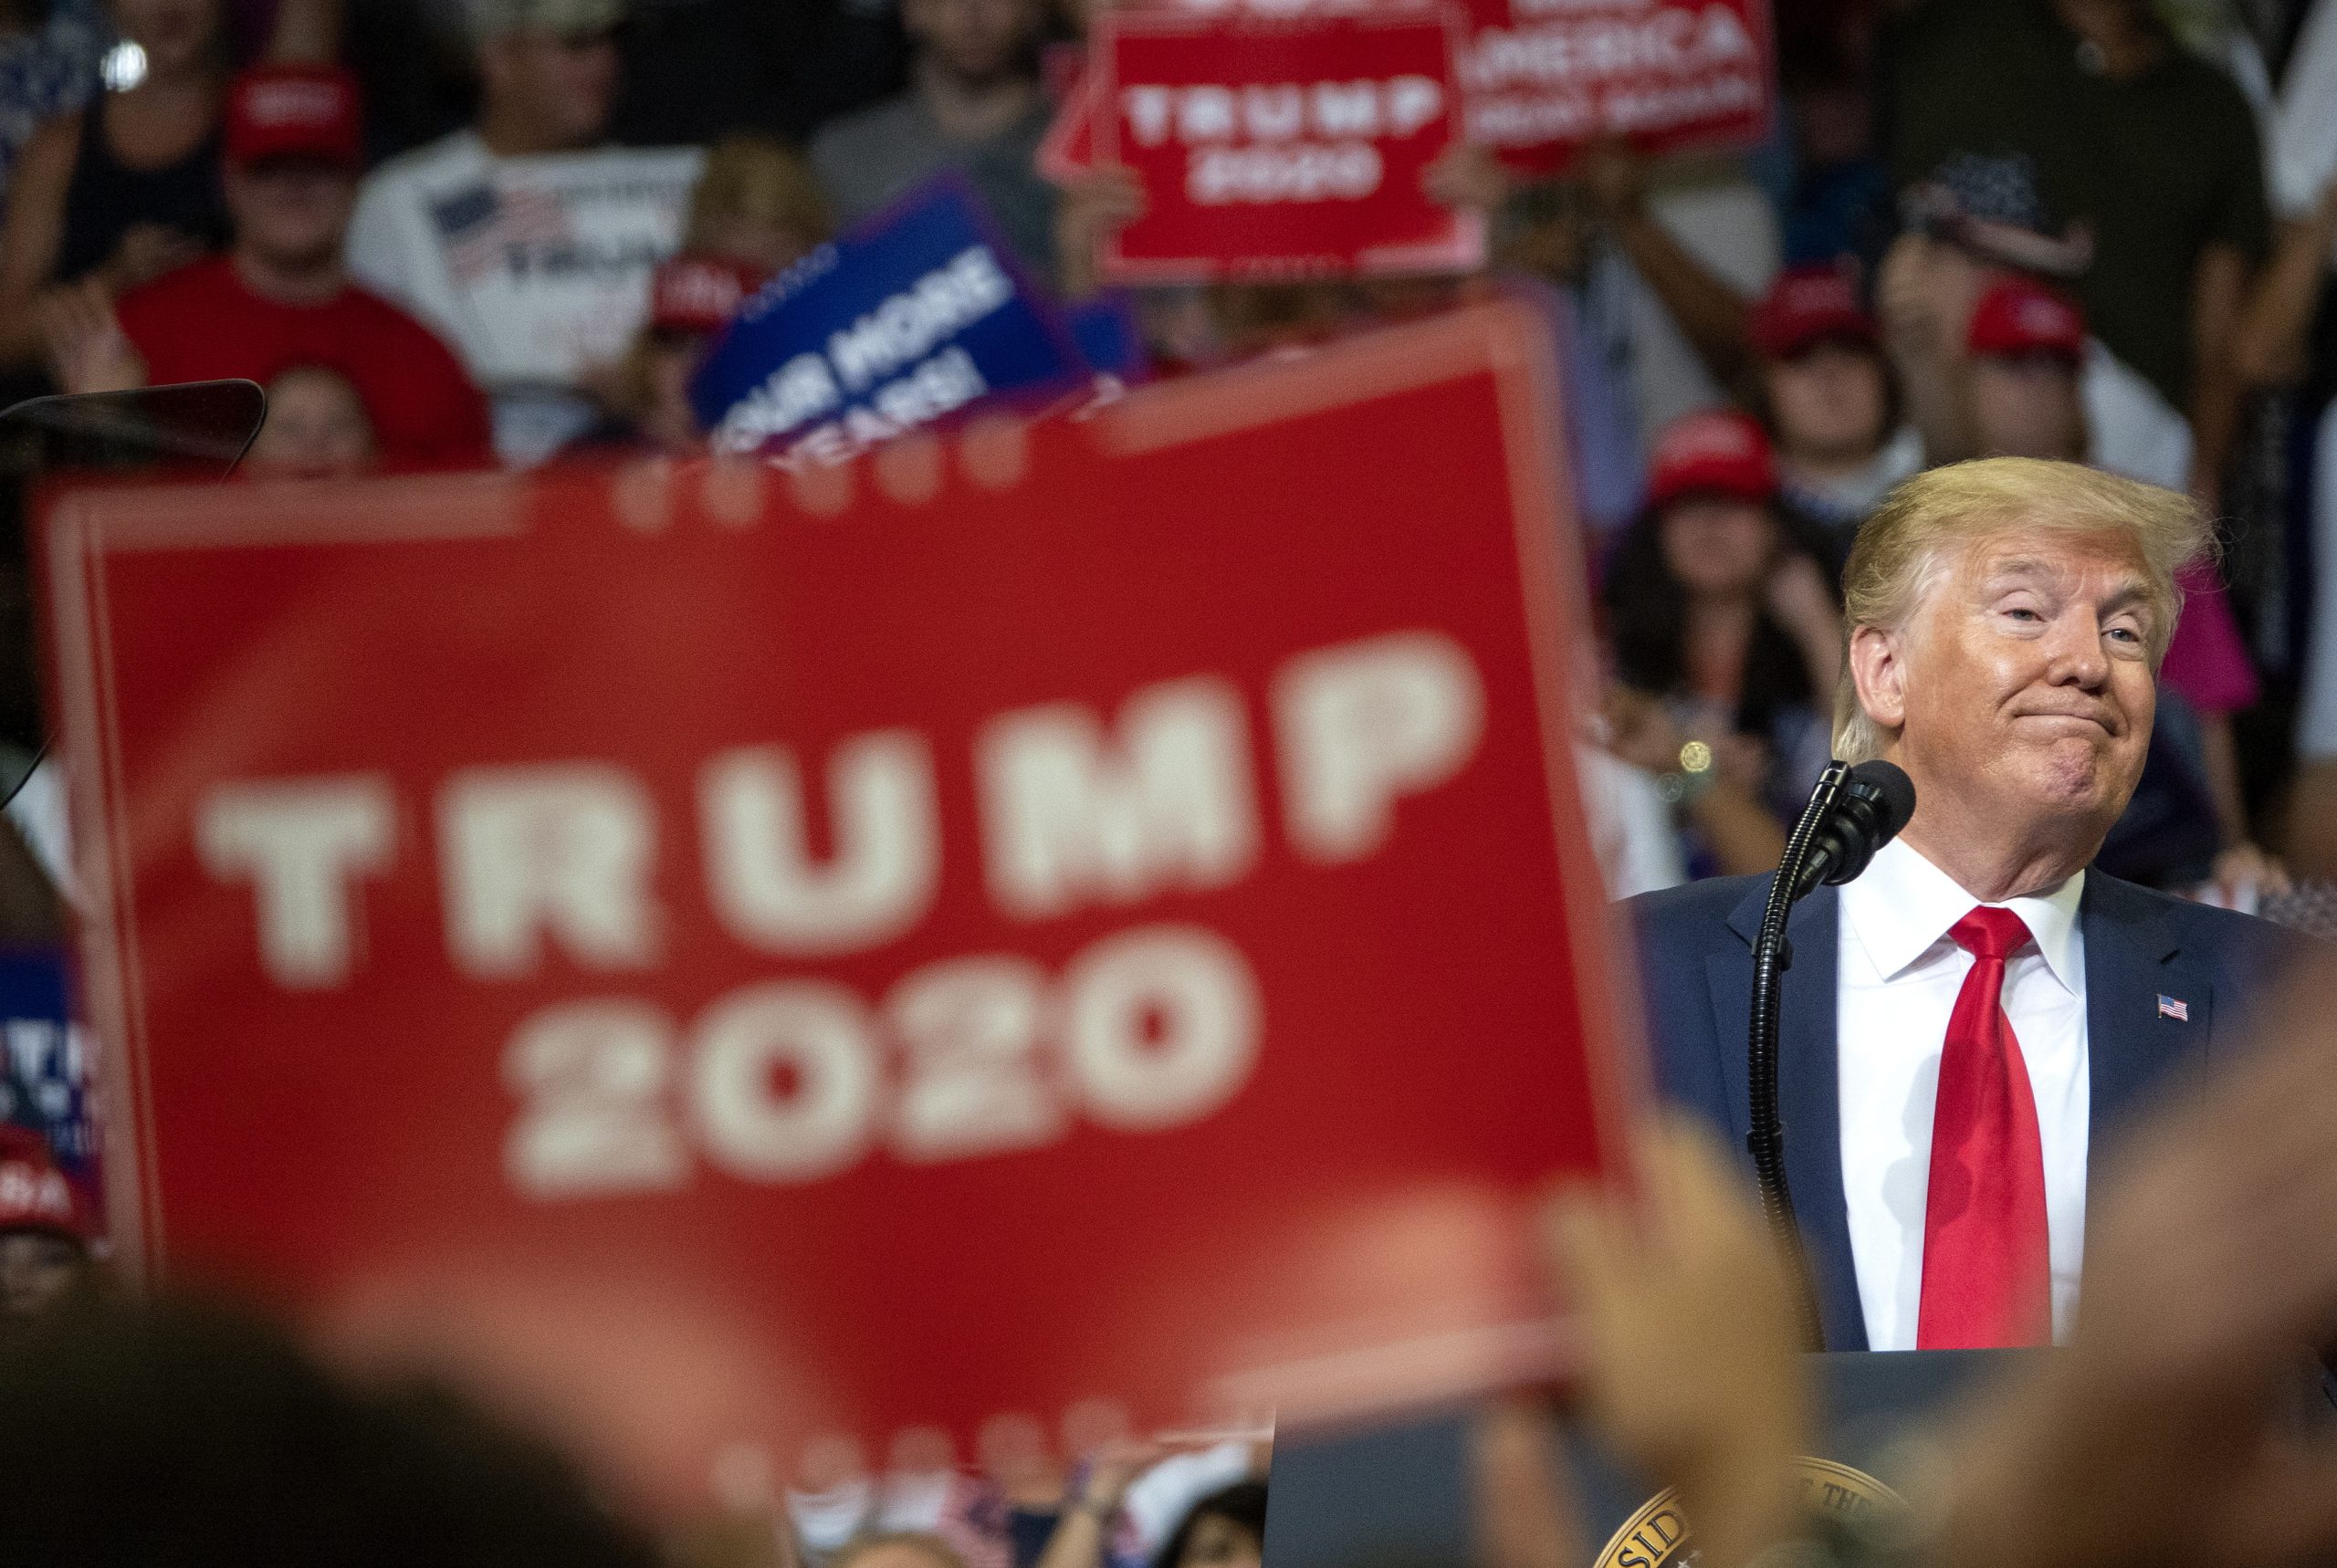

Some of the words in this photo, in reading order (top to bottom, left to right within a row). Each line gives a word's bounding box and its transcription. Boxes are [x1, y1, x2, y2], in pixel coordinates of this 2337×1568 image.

[1122, 75, 1443, 147] TRUMP
[1185, 140, 1384, 206] 2020
[710, 351, 842, 458] OUR
[828, 243, 1016, 392] MORE
[194, 630, 1486, 990] TRUMP
[498, 922, 1269, 1203] 2020
